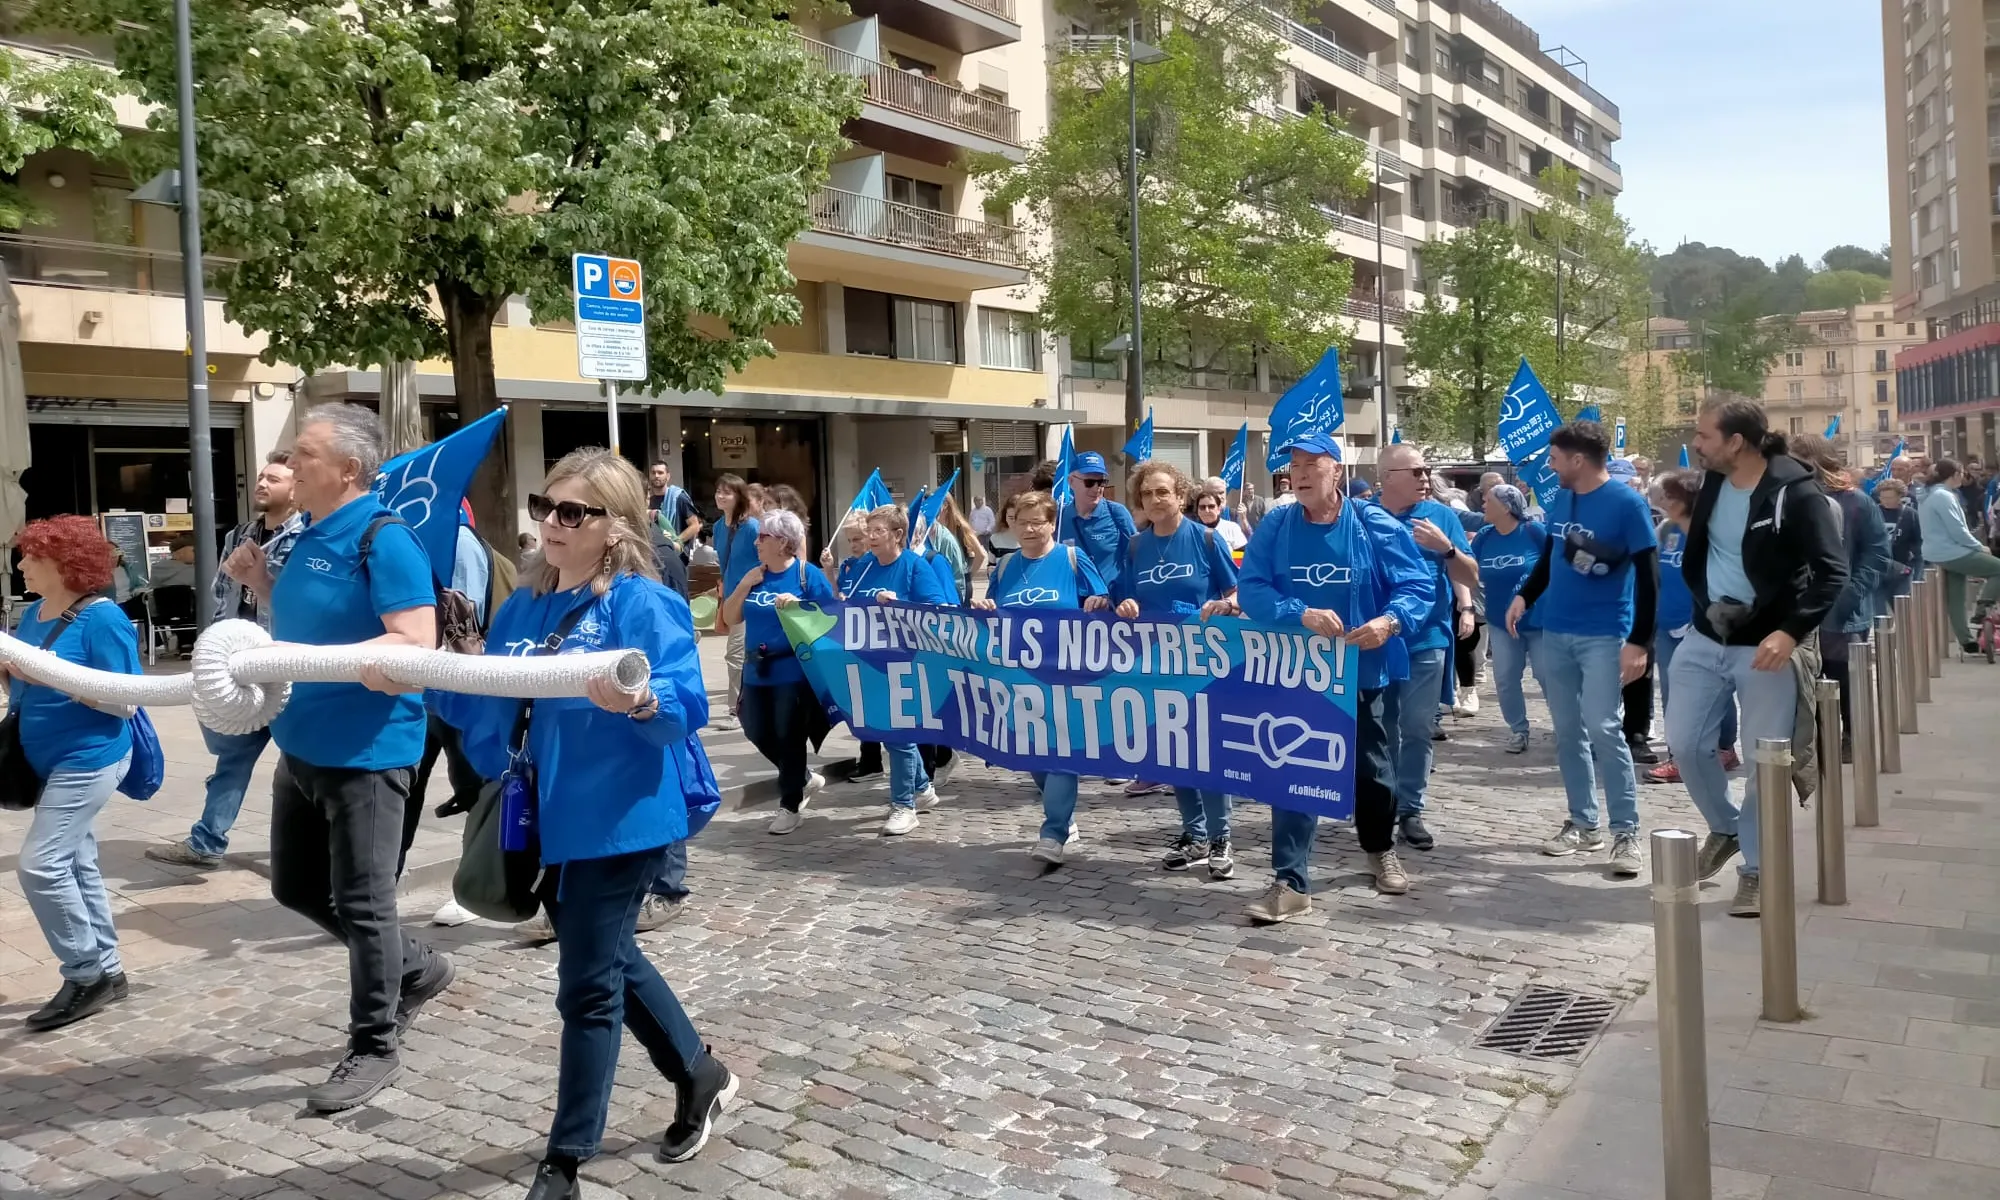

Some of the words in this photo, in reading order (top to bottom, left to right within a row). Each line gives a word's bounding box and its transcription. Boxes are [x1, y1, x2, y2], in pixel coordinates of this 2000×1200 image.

[584, 263, 602, 290] P
[1617, 427, 1624, 446] P
[844, 606, 980, 662] DEFENSEM
[986, 617, 1043, 669] ELS
[1057, 619, 1231, 679] NOSTRES
[1240, 629, 1346, 695] RIUS!
[846, 664, 865, 728] I
[887, 661, 944, 730] EL
[946, 668, 1210, 773] TERRITORI
[1223, 768, 1252, 782] ebre.net
